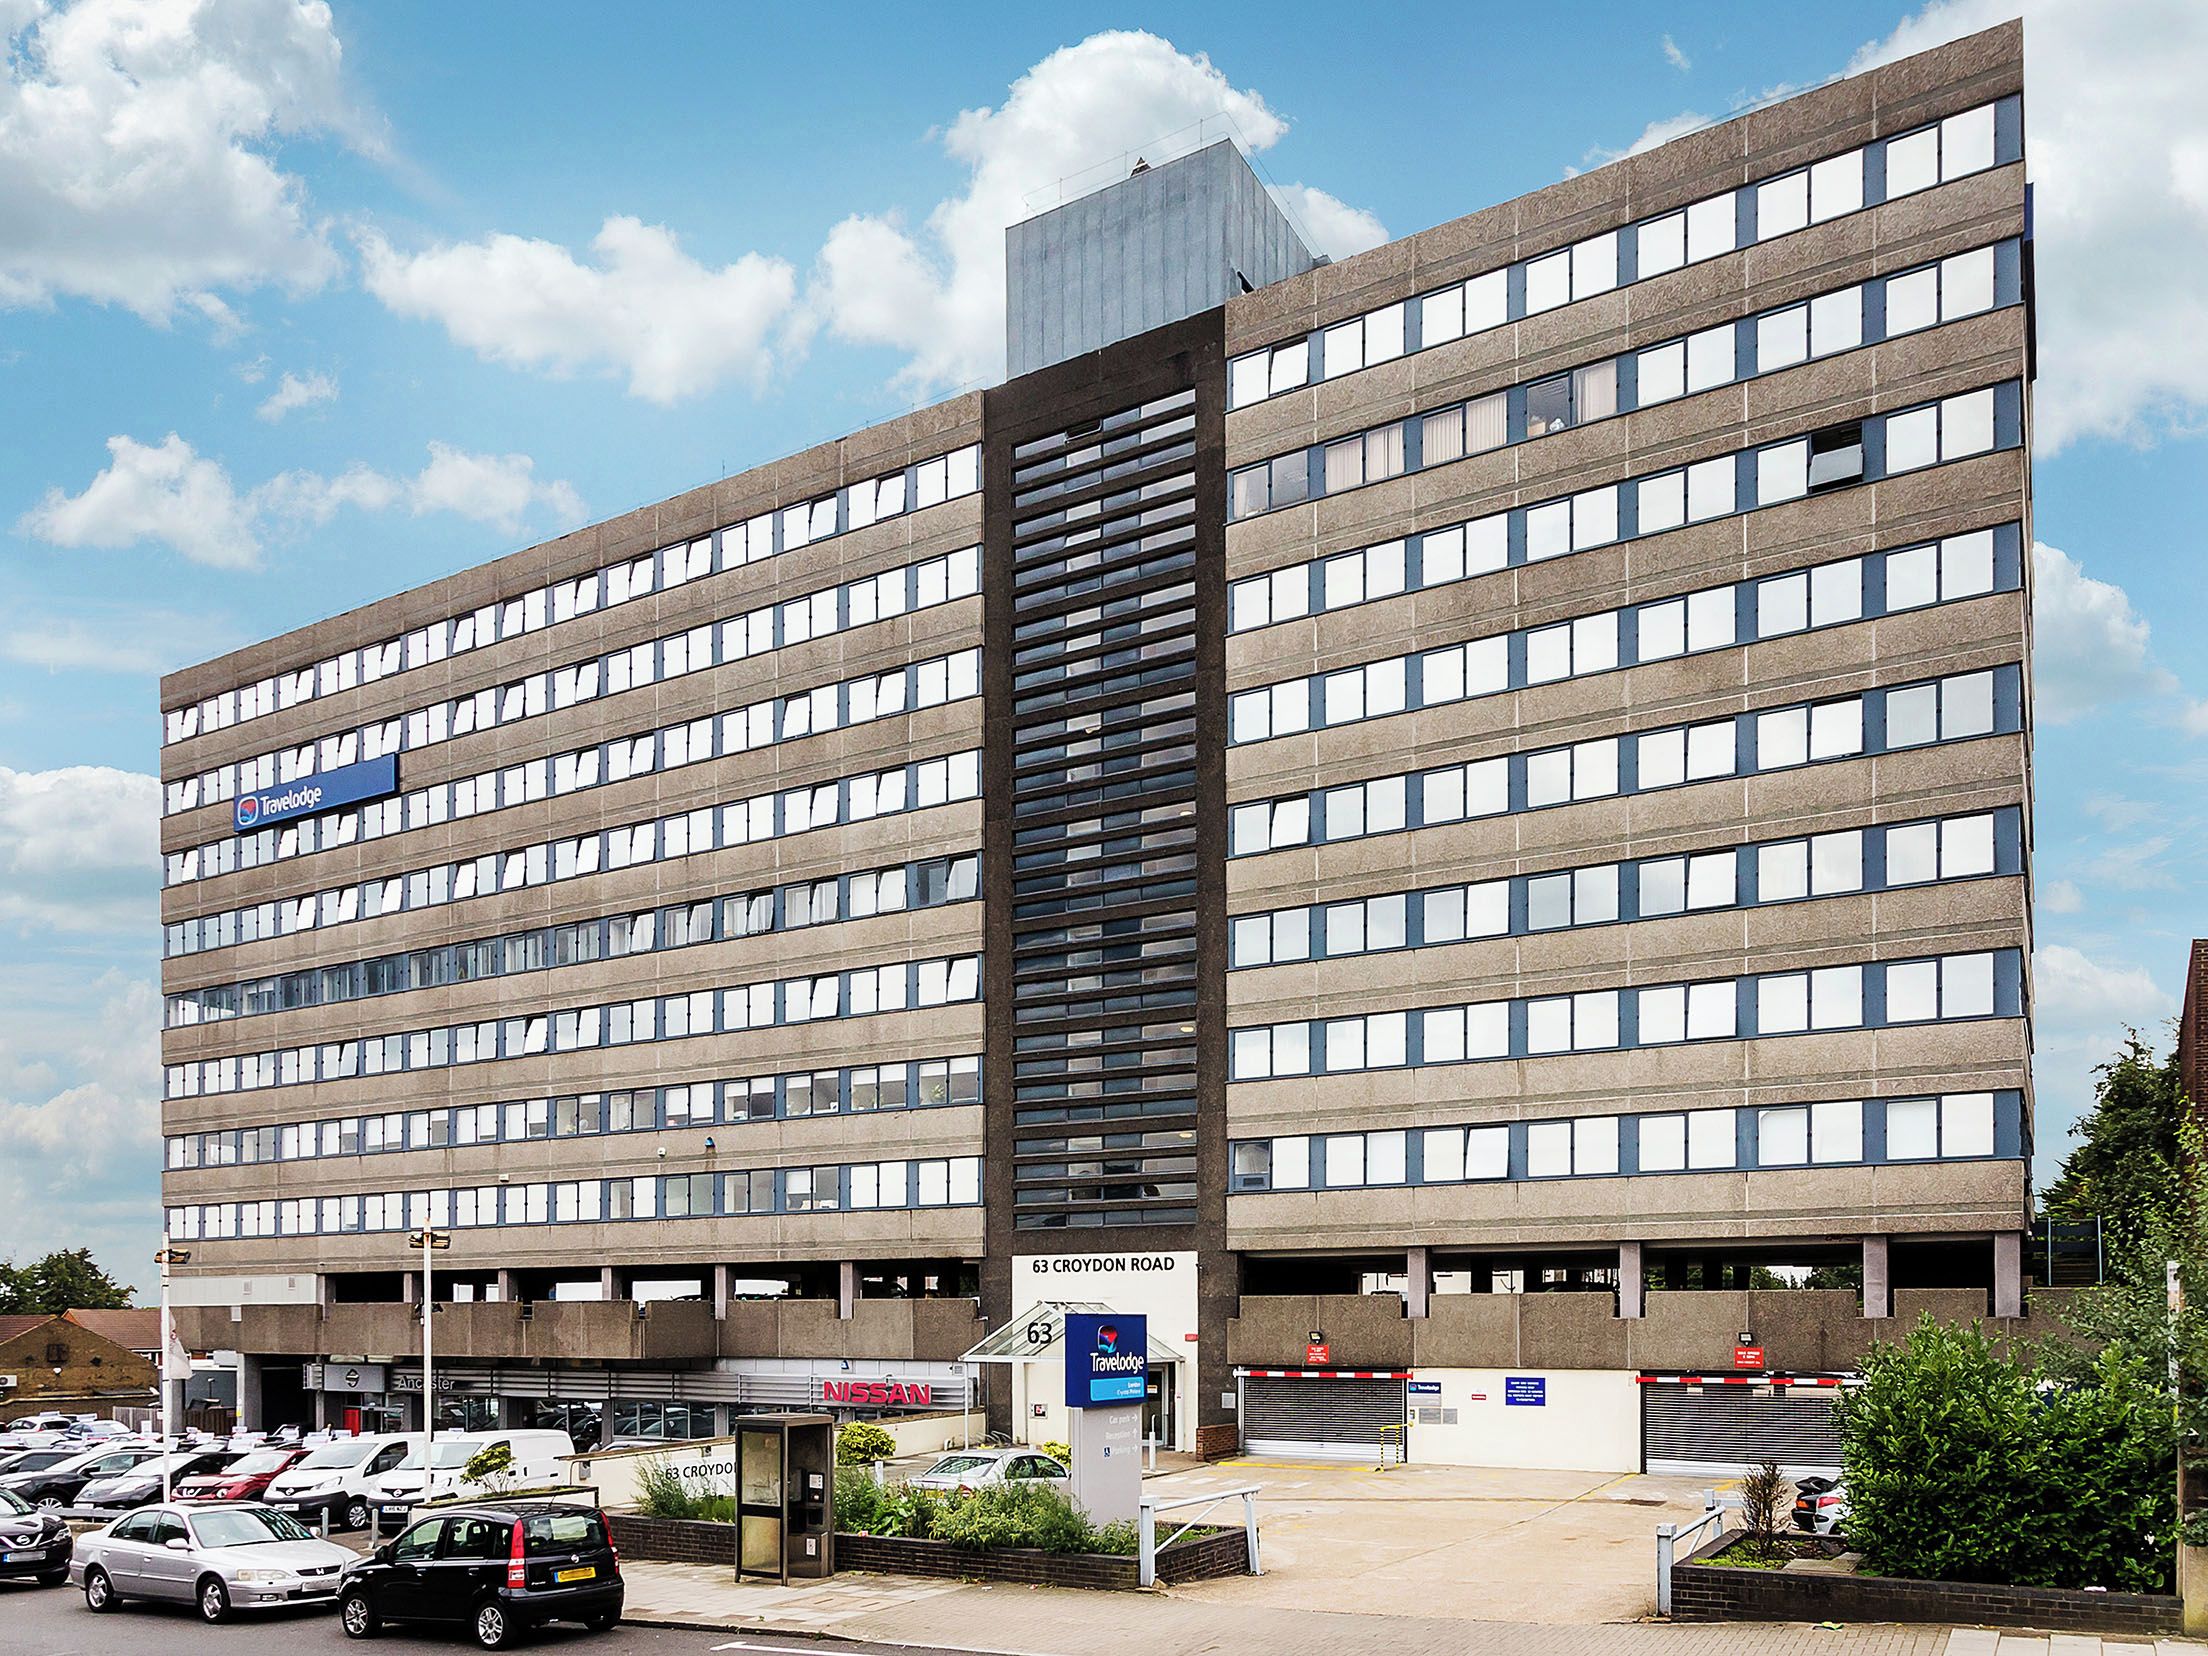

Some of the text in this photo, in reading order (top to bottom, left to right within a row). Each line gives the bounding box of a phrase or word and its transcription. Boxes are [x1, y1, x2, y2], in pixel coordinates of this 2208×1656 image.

[260, 786, 322, 816] Travelodge
[1032, 1257, 1175, 1273] 63 CROYDON ROAD
[1027, 1322, 1053, 1344] 63
[1089, 1352, 1145, 1375] Travelodge
[398, 1376, 455, 1390] Ancster
[823, 1381, 931, 1405] NISSAN
[665, 1467, 679, 1480] 63
